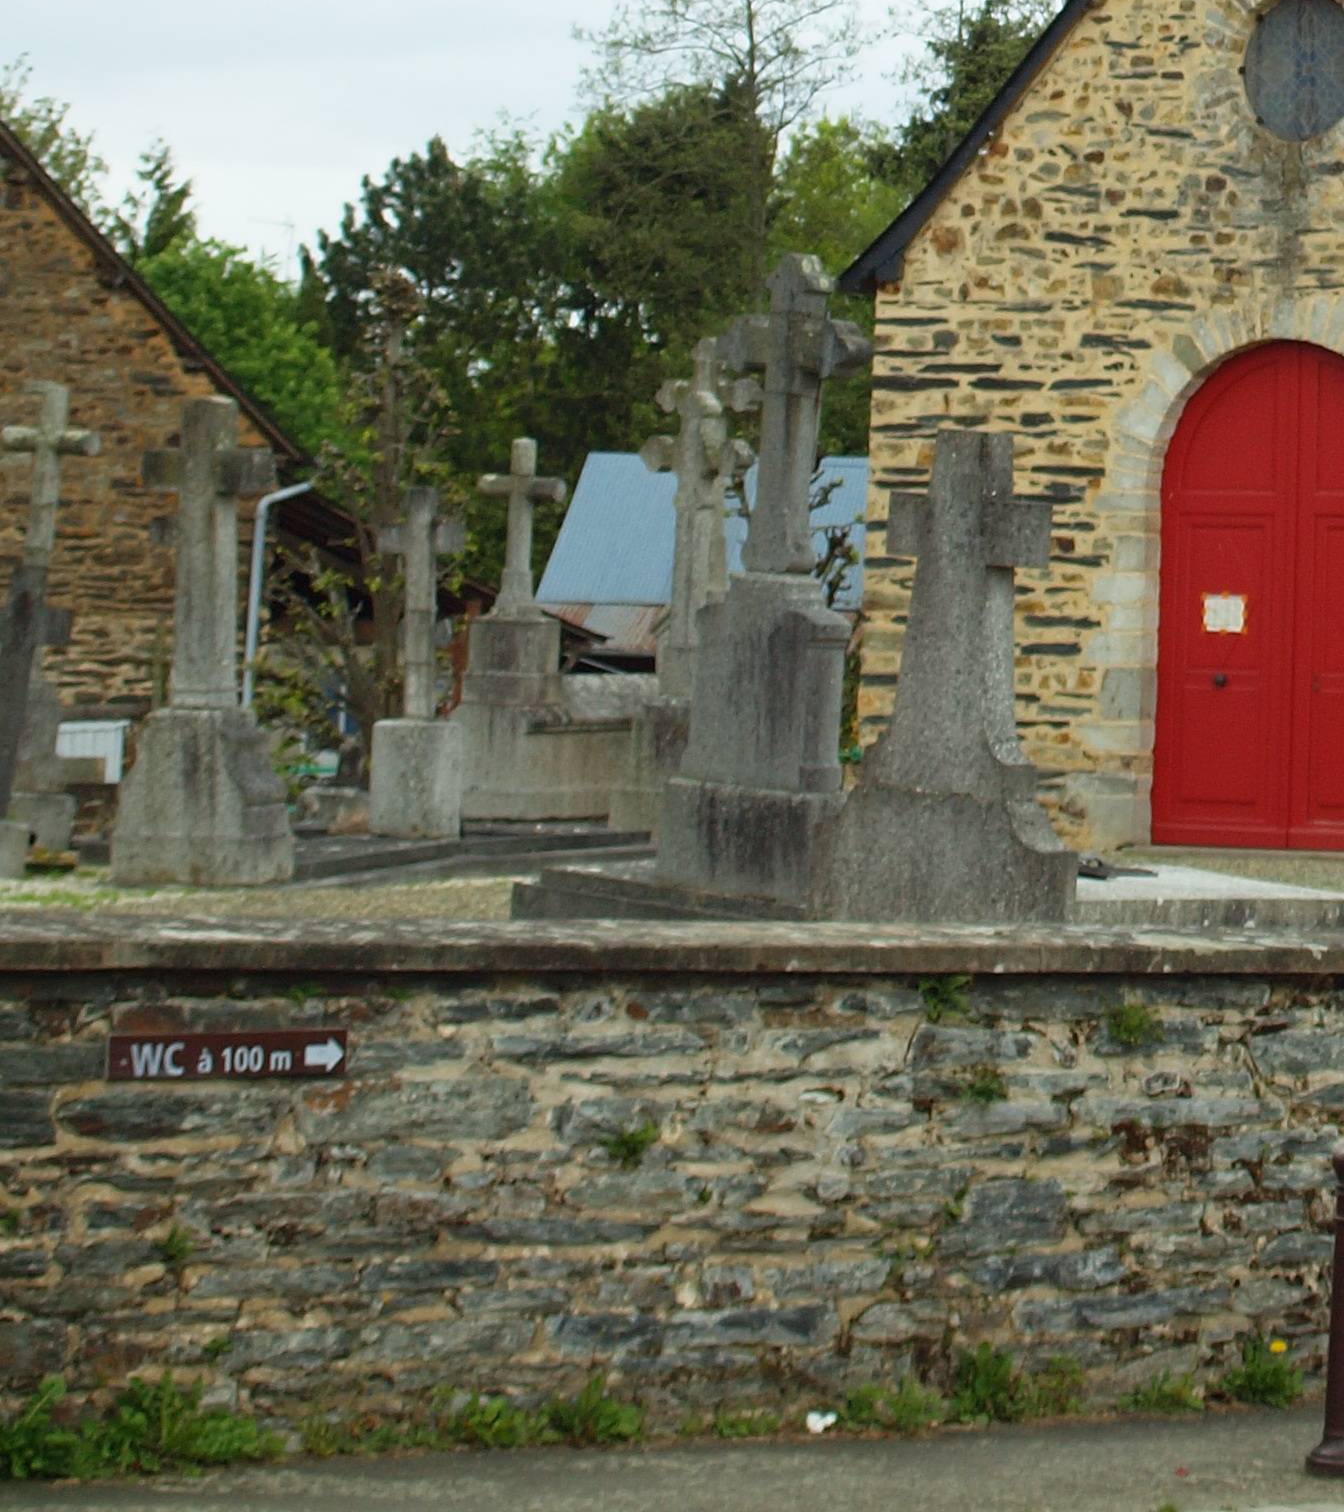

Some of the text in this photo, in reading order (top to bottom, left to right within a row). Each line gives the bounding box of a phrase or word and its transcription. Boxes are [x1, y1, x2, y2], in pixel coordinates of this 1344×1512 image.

[131, 1042, 185, 1077] WC
[221, 1045, 264, 1072] 100
[270, 1050, 292, 1071] m
